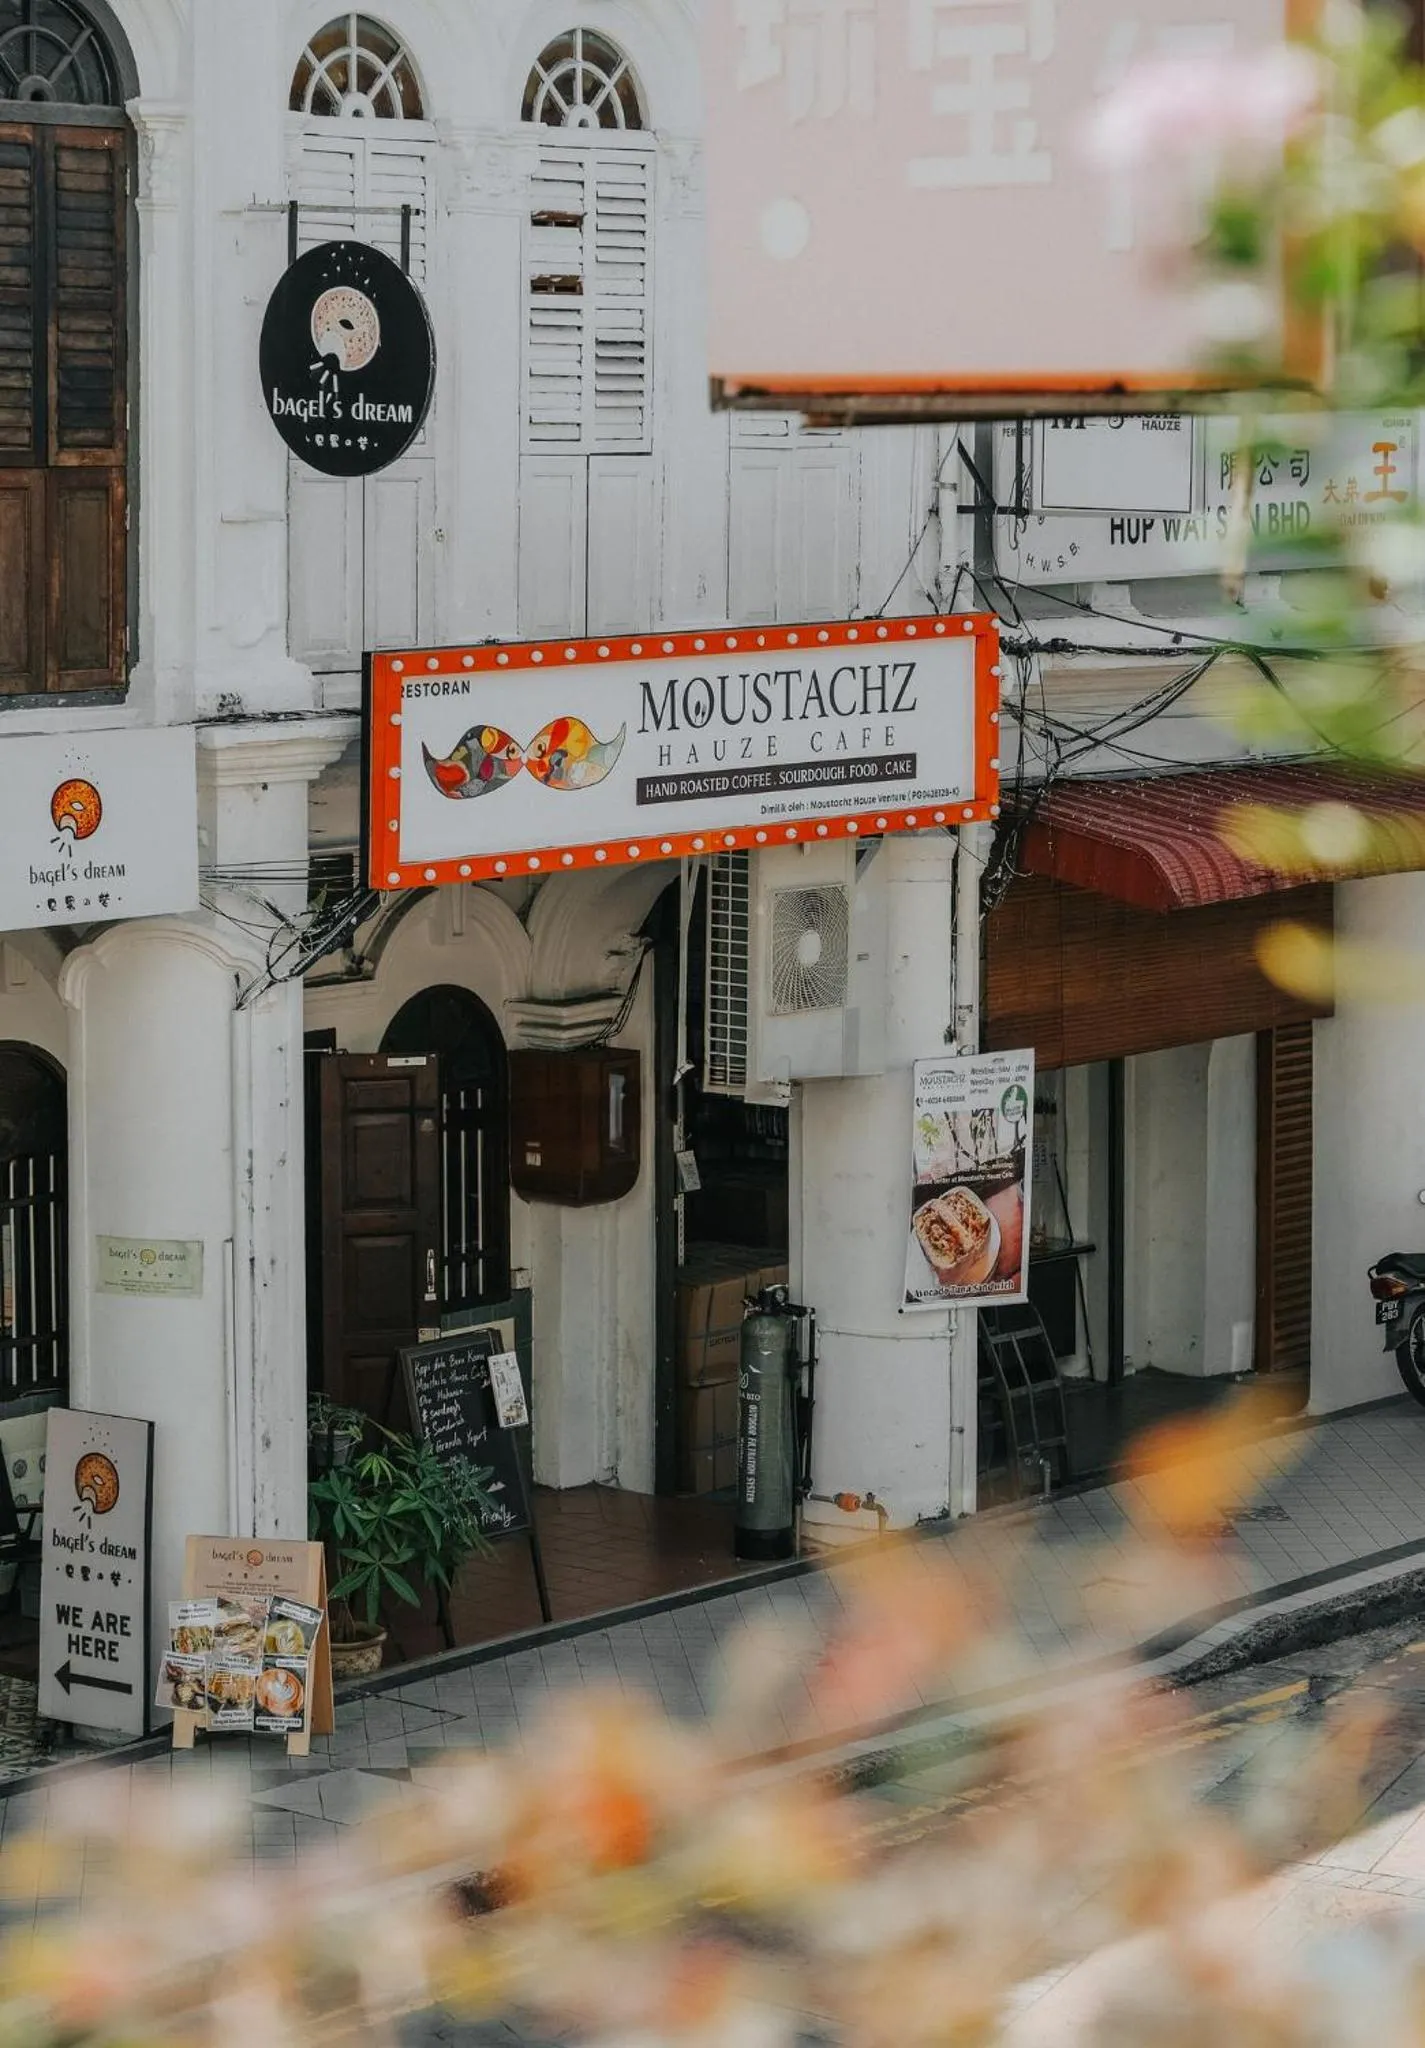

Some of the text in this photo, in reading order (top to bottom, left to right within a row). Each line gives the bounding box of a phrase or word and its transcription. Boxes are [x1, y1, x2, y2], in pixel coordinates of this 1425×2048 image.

[1141, 421, 1181, 431] HAUZE
[1110, 516, 1154, 545] HUP
[1267, 501, 1311, 537] BHD
[636, 661, 918, 734] MOUSTACHZ
[659, 726, 896, 767] HAUZE CAFE
[646, 783, 678, 799] HAND
[680, 777, 730, 795] ROASTED
[732, 772, 771, 790] COFFEE
[849, 763, 878, 778] FOOD
[885, 760, 912, 775] CAKE
[56, 1603, 131, 1637] WE ARE
[68, 1633, 120, 1662] HERE
